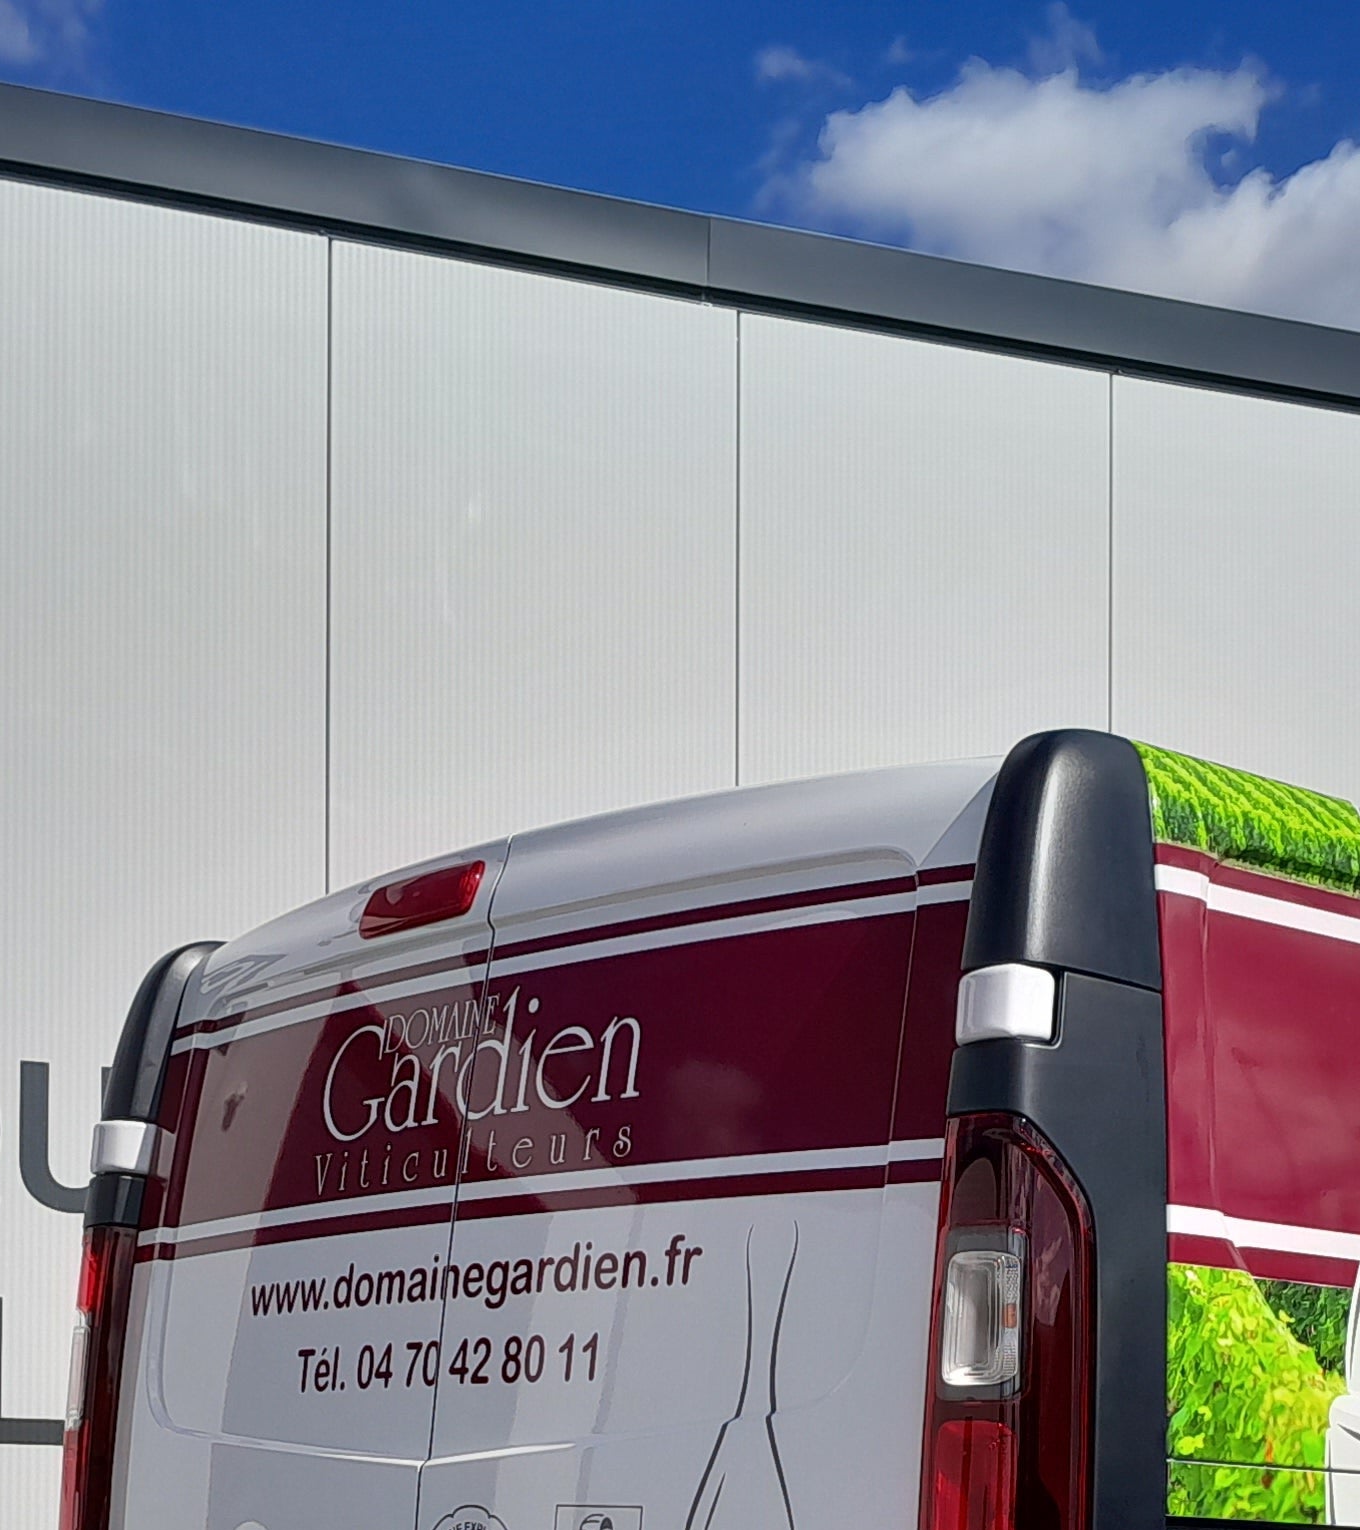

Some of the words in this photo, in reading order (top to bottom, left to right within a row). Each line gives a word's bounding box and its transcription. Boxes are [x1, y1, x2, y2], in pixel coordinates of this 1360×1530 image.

[384, 993, 499, 1054] DOMAINE
[323, 985, 641, 1142] Gardien
[313, 1124, 633, 1196] Viticulteurs
[251, 1234, 703, 1316] www.domainegardien.fr
[298, 1346, 346, 1393] Tél.
[356, 1341, 393, 1390] 04
[405, 1340, 439, 1388] 70
[448, 1336, 490, 1385] 42
[501, 1333, 545, 1384] 80
[558, 1332, 600, 1382] 11
